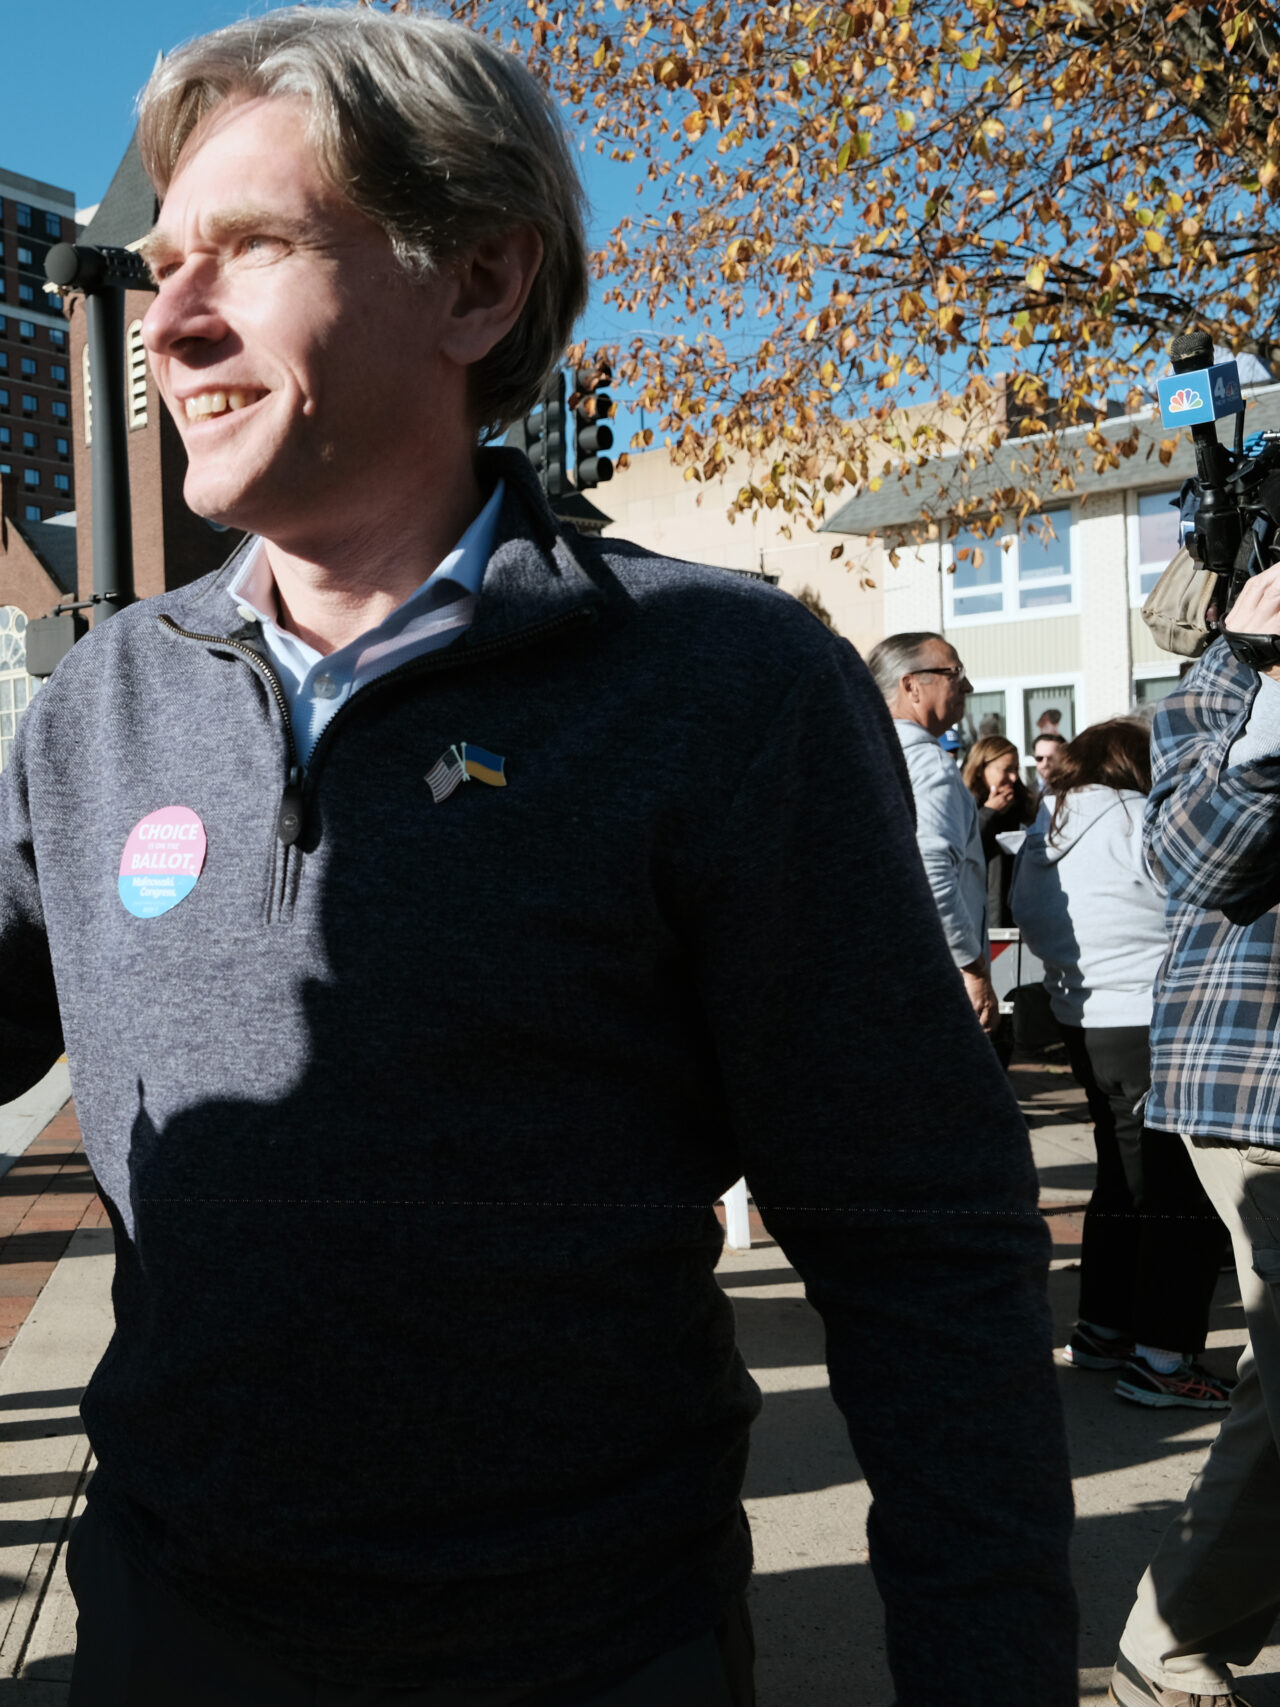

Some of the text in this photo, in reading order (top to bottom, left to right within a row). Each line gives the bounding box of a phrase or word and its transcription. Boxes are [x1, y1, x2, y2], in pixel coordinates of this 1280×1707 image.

[1214, 377, 1225, 399] 4
[138, 823, 199, 840] CHOICE
[131, 853, 197, 870] BALLOT.
